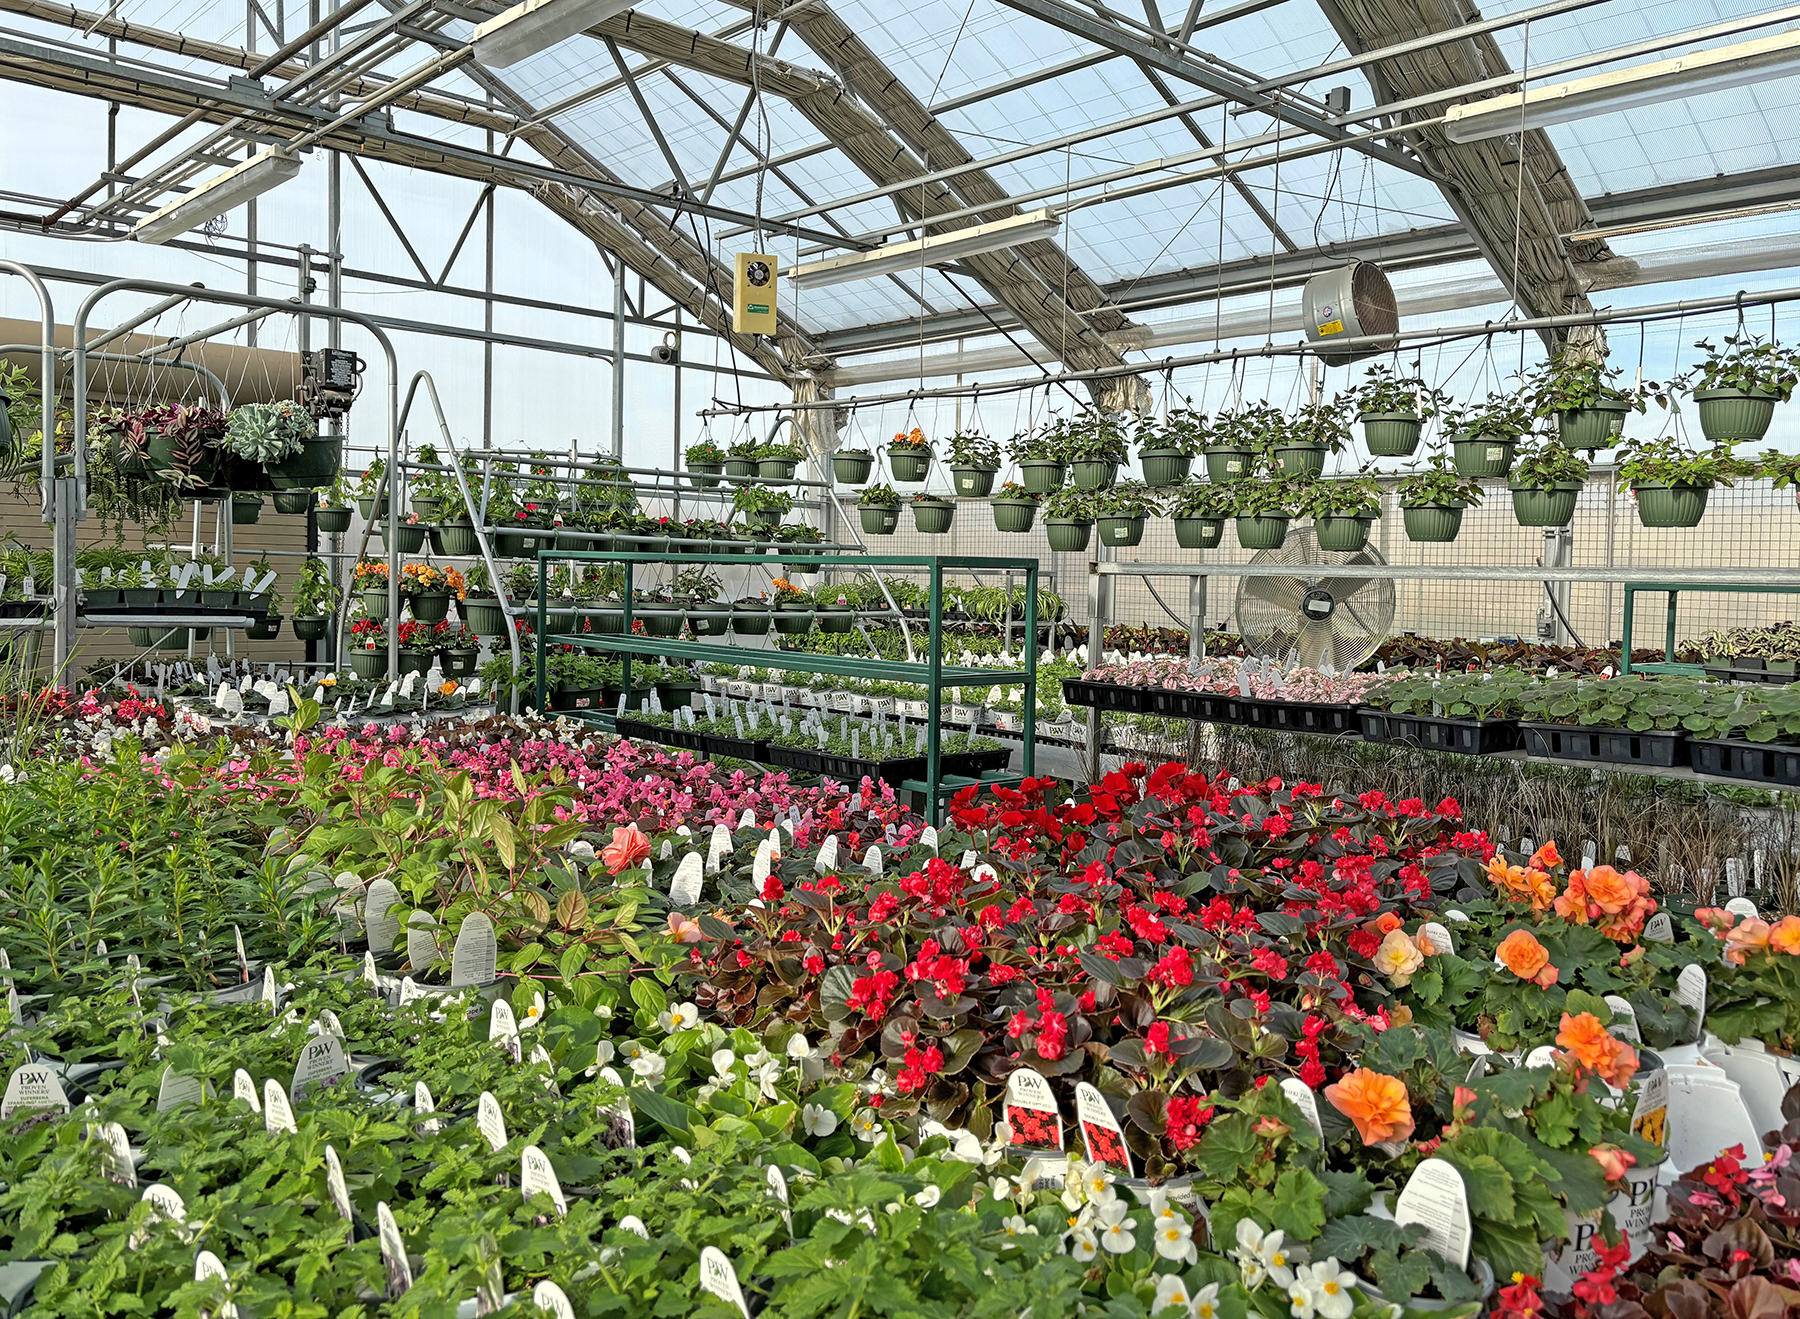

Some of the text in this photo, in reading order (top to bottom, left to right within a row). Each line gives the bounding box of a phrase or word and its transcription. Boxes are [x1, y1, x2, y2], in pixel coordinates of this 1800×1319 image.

[878, 699, 892, 707] PW
[955, 707, 968, 716] PW
[1049, 726, 1064, 735] PW
[495, 1007, 509, 1019] PW
[308, 1041, 334, 1060] PW
[309, 1055, 331, 1065] PROVEN
[19, 1072, 49, 1085] PW
[1017, 1075, 1043, 1089] PW
[1019, 1087, 1042, 1095] PROVEN
[1080, 1089, 1101, 1105] PW
[527, 1155, 546, 1174] PW
[706, 1257, 728, 1281] PW
